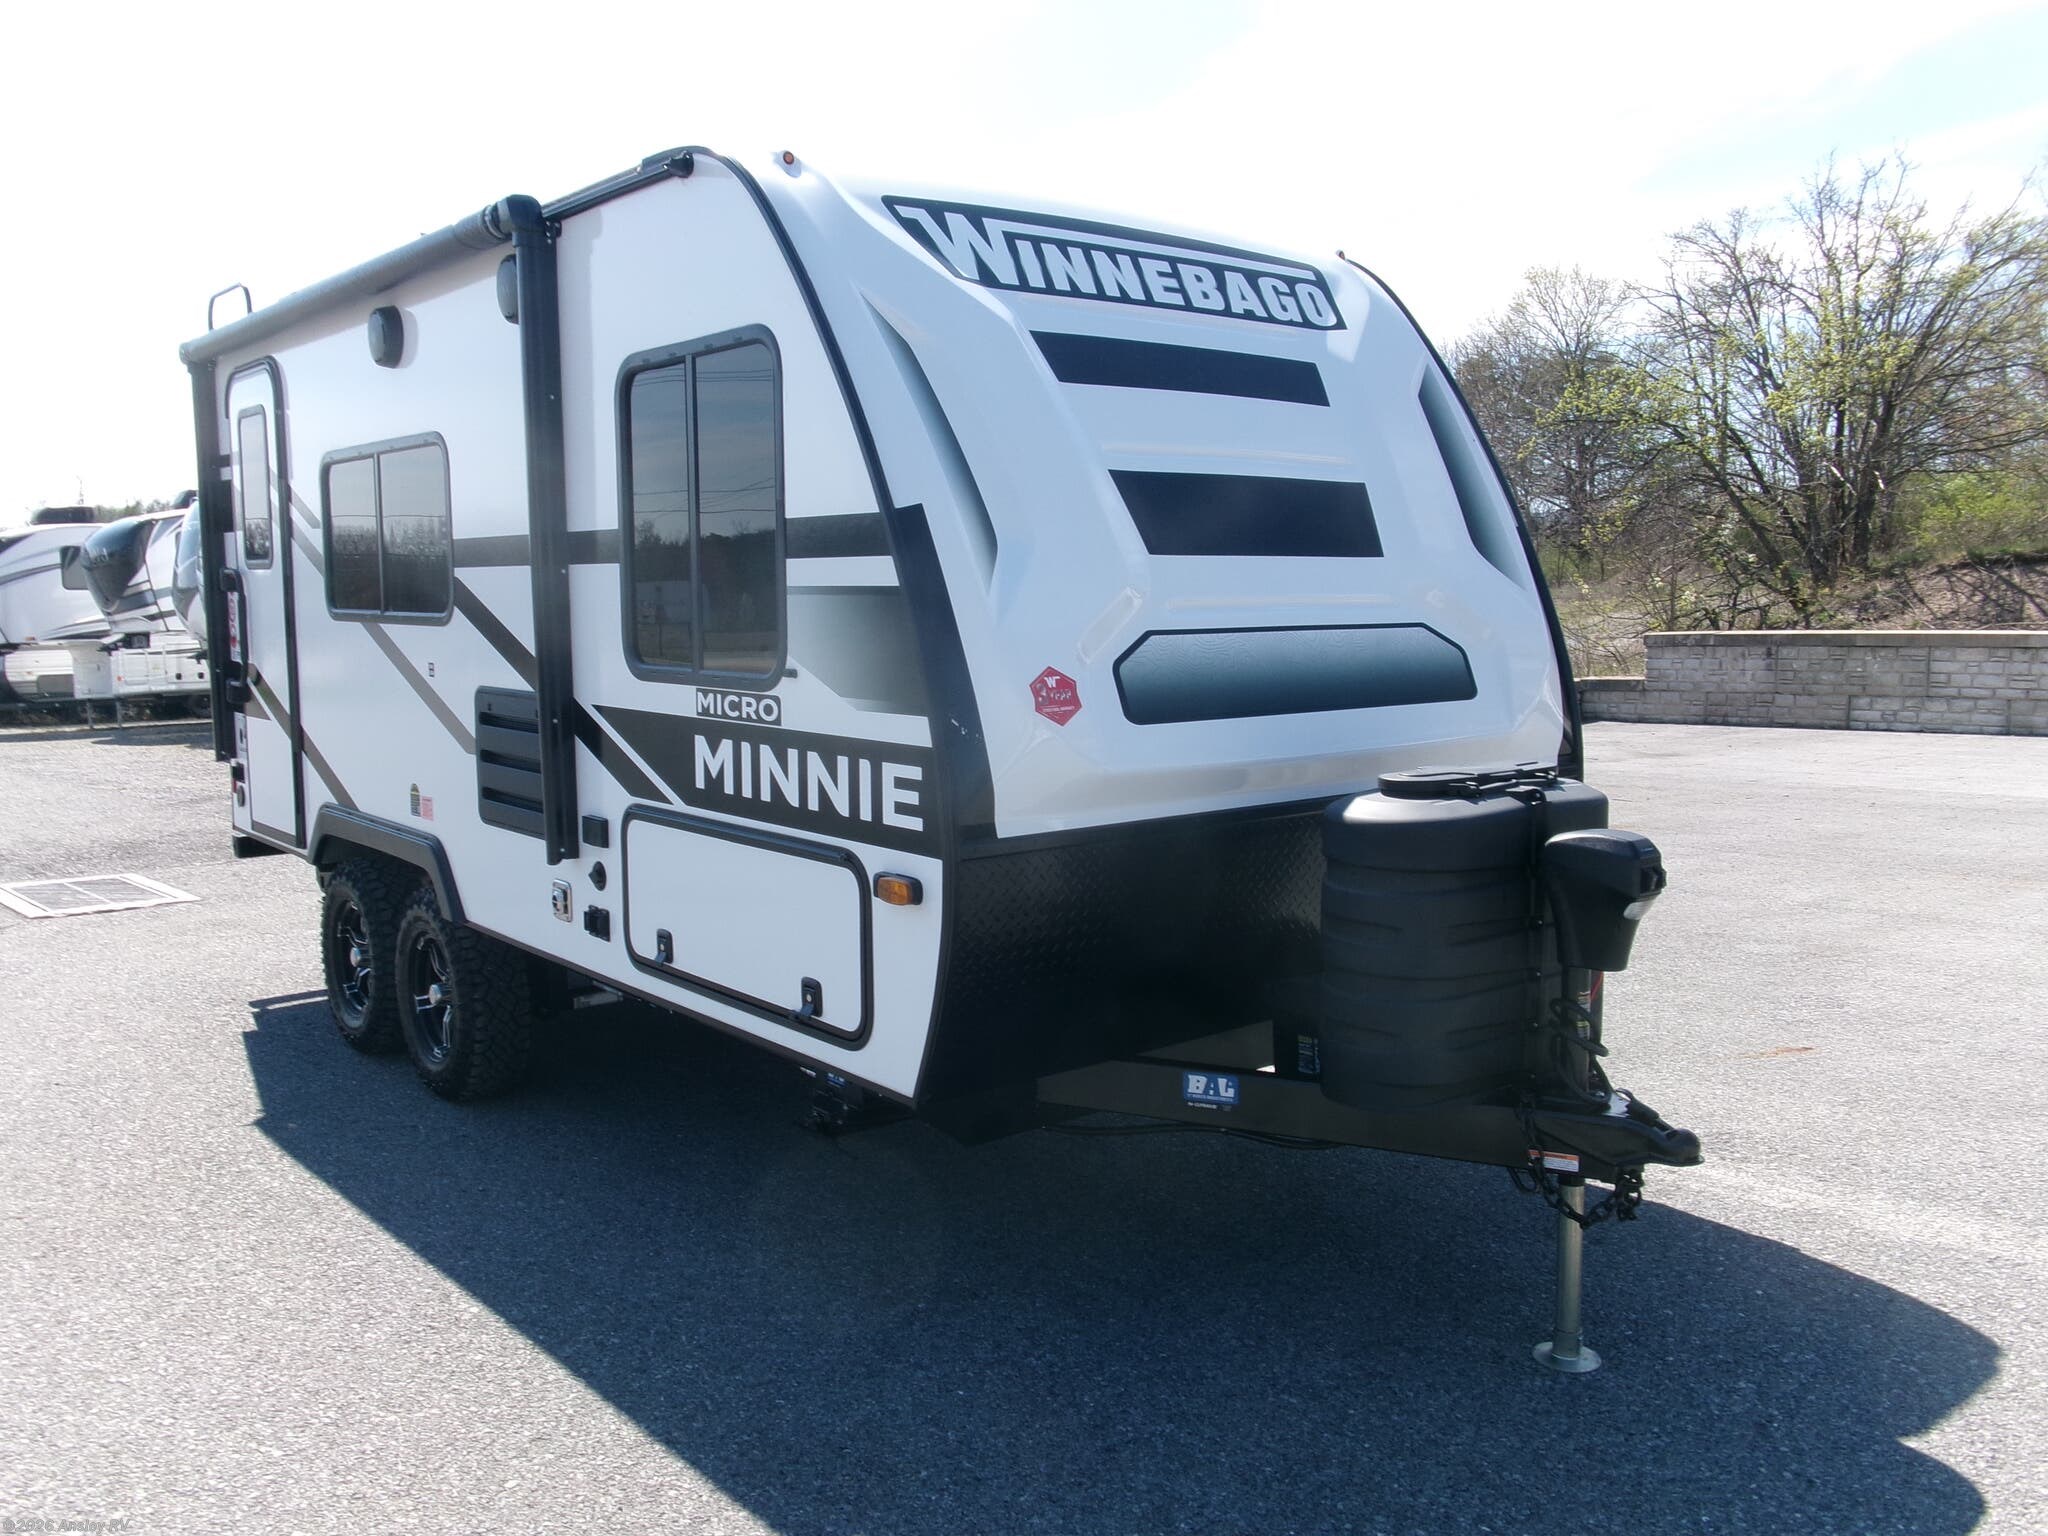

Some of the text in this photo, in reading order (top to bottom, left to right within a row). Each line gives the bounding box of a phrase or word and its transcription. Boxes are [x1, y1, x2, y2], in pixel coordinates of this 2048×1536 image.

[895, 205, 1340, 327] WINNEBAGO
[696, 691, 779, 722] MICRO
[694, 734, 924, 832] MINNIE
